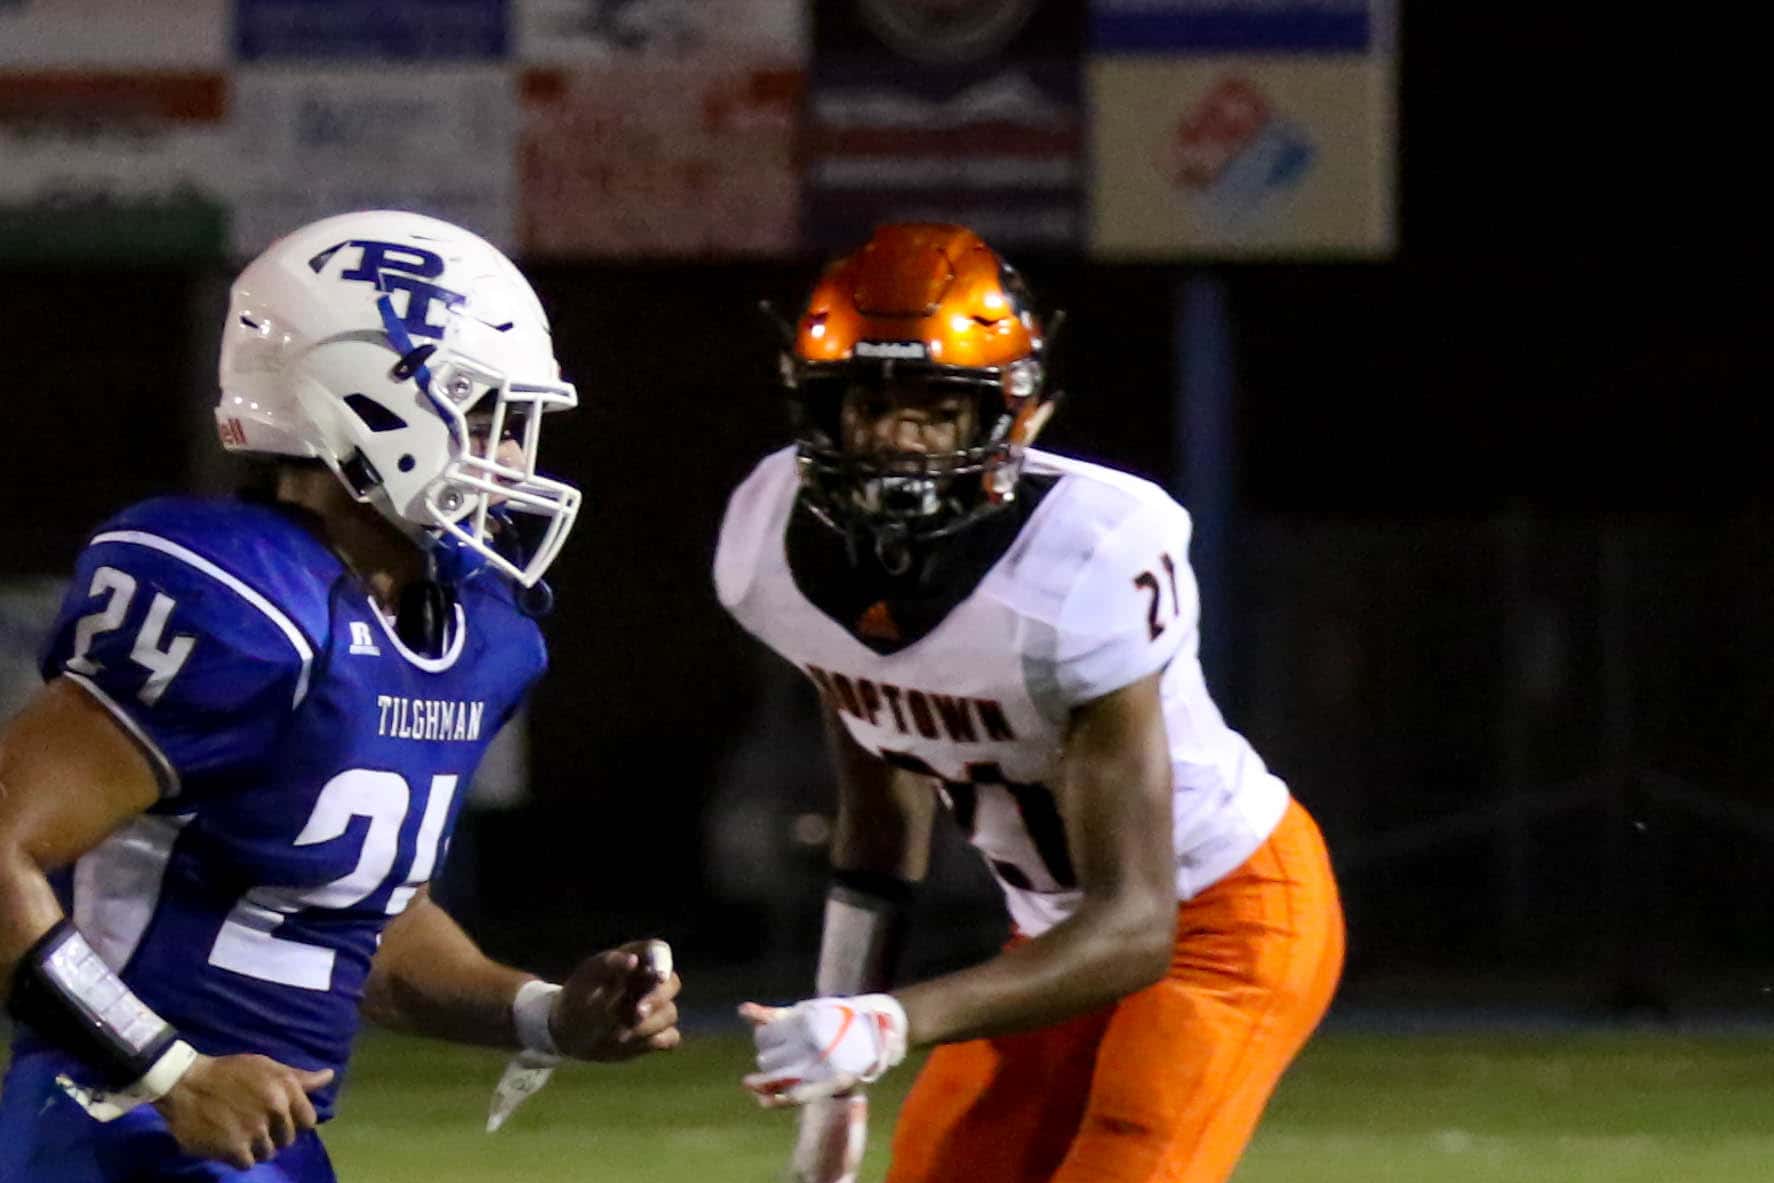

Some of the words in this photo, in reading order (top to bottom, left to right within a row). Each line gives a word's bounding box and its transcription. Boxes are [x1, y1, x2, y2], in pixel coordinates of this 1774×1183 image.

[65, 566, 196, 708] 24
[1133, 552, 1179, 641] 21
[377, 694, 484, 741] TILGHMAN
